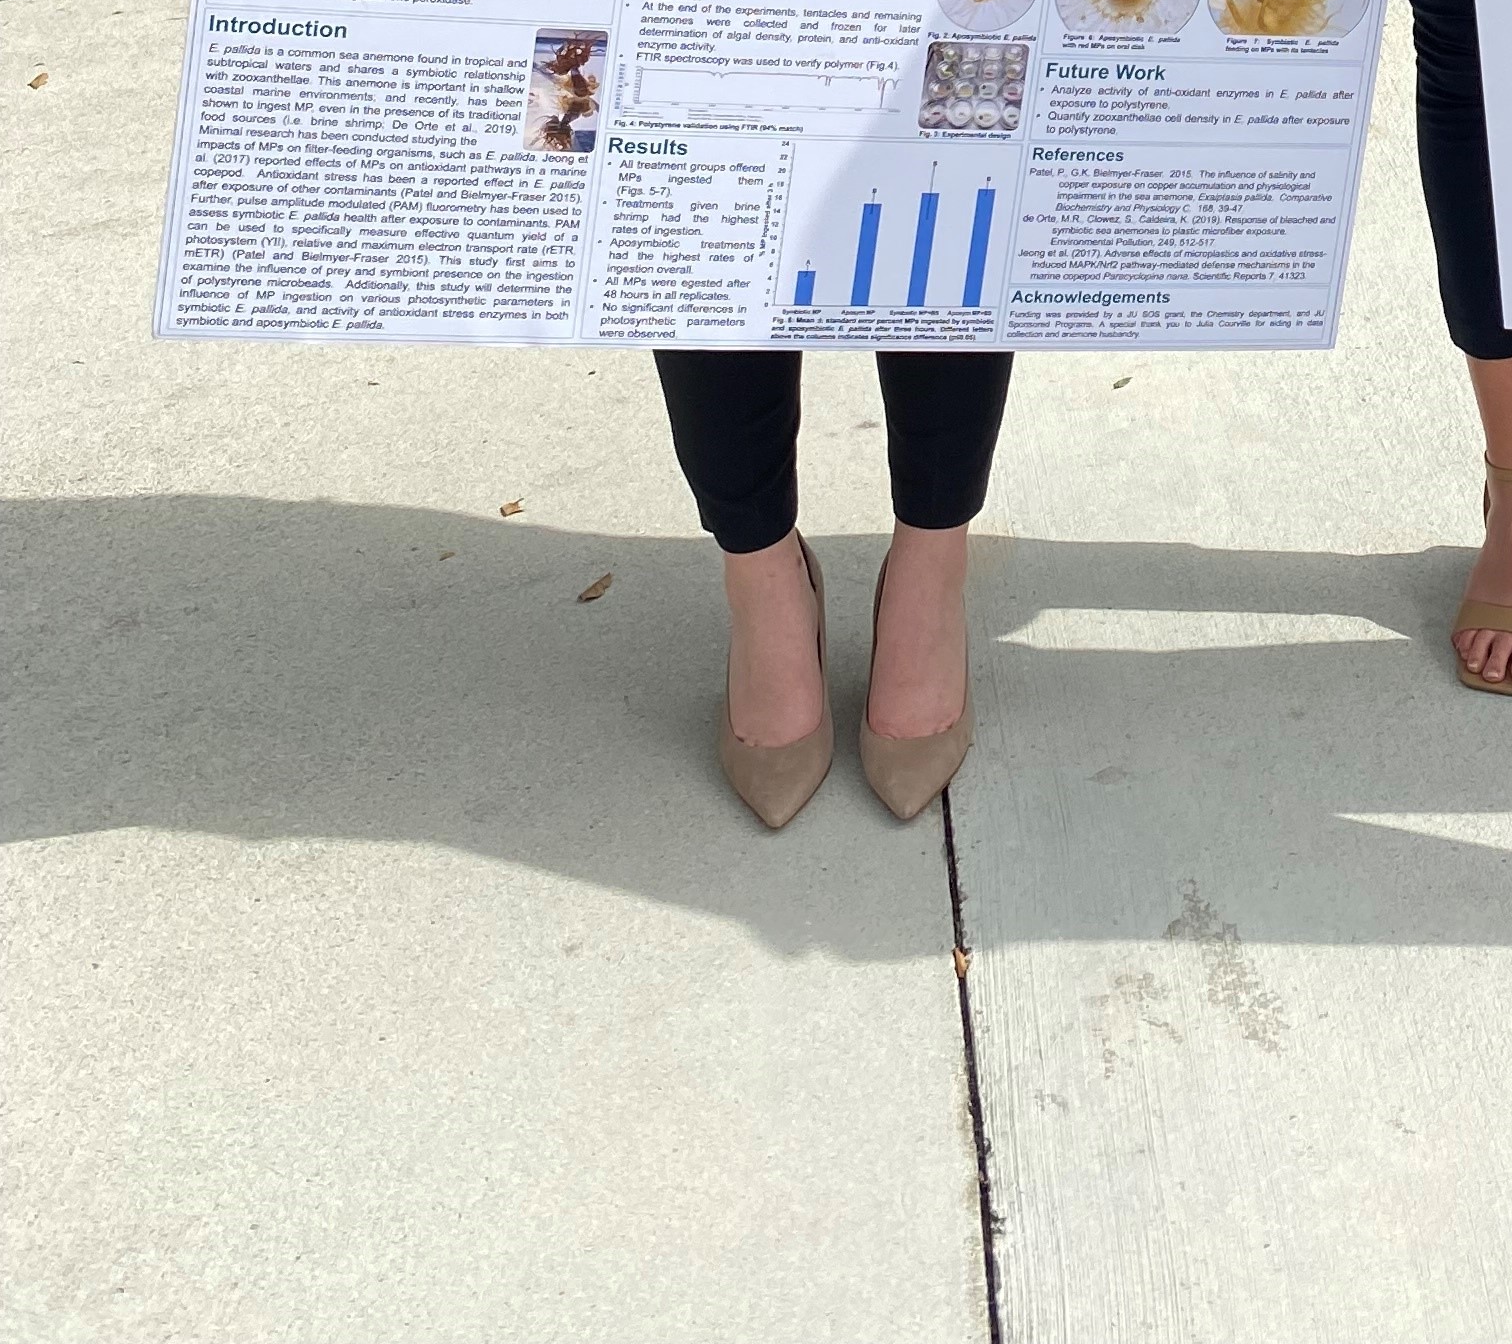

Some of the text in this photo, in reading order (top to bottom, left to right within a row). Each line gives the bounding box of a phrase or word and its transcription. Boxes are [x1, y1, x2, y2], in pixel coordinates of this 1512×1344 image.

[208, 14, 347, 39] Introduction
[1045, 62, 1166, 81] Future Work
[608, 136, 688, 156] Results
[1032, 147, 1124, 162] References
[619, 159, 766, 174] All treatment groups offered
[1010, 289, 1171, 307] Acknowledgements
